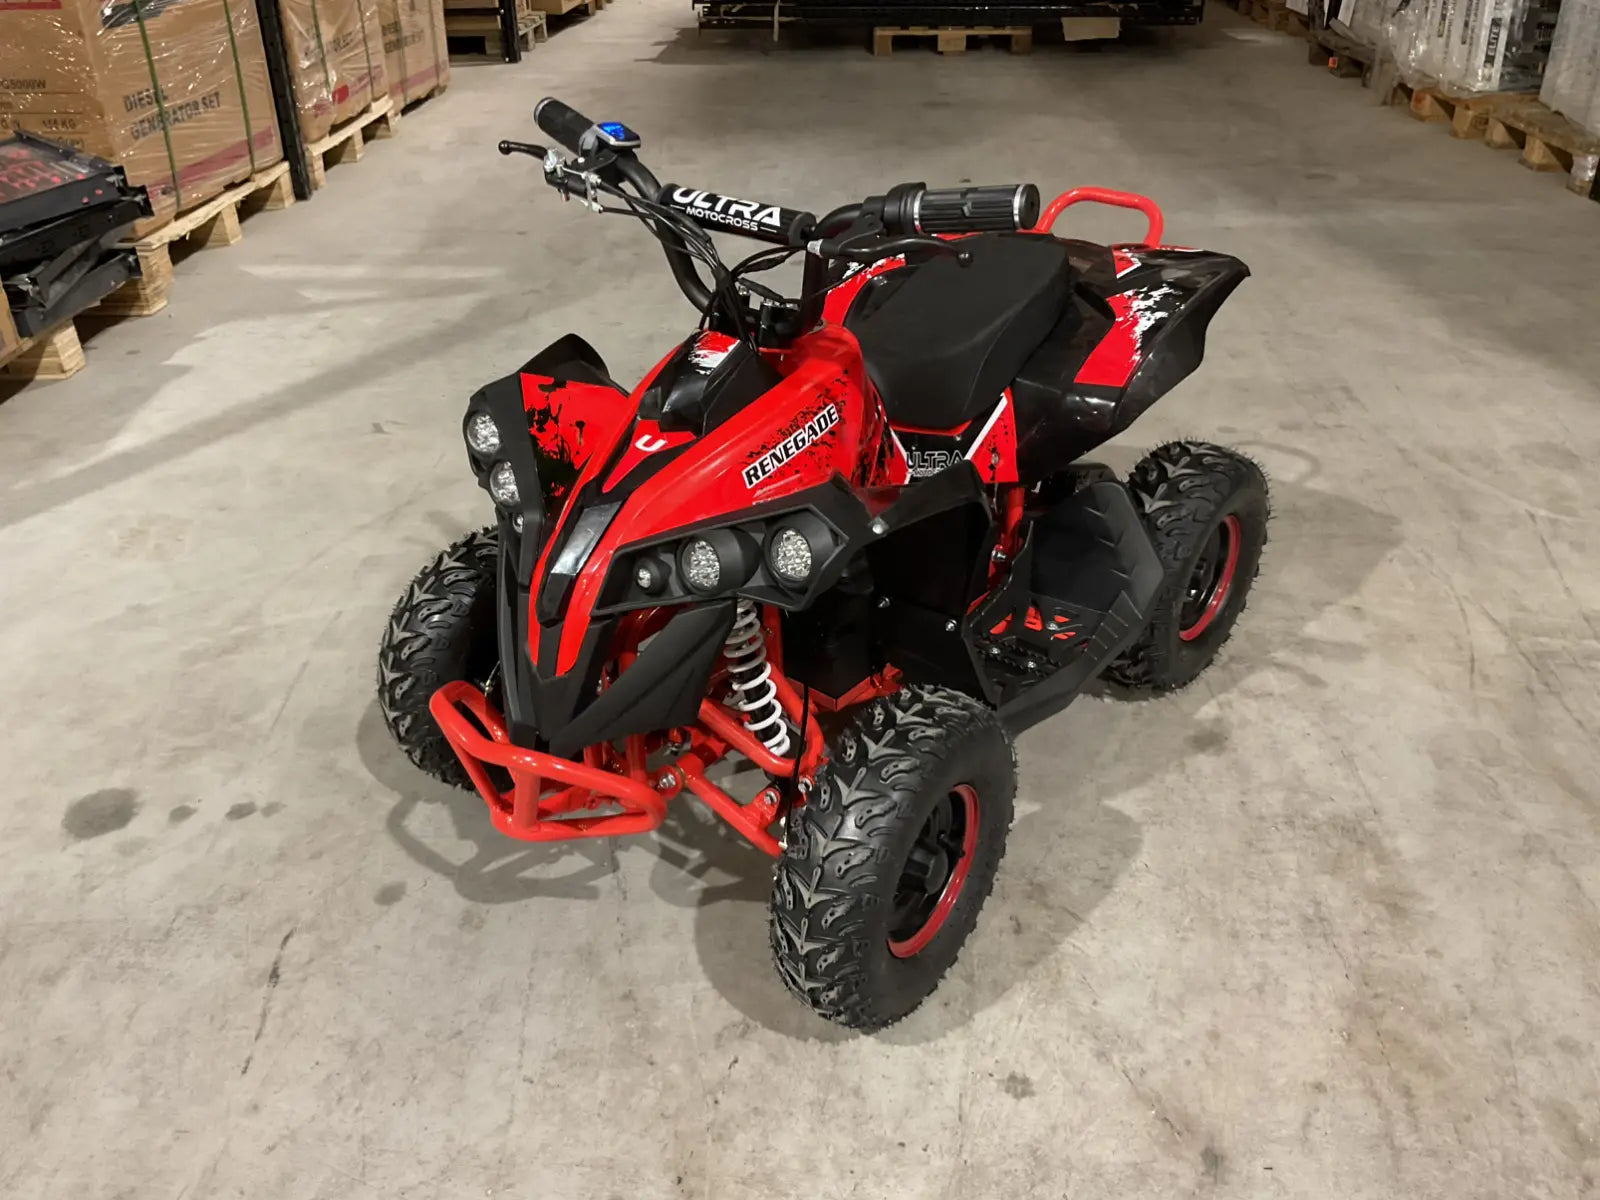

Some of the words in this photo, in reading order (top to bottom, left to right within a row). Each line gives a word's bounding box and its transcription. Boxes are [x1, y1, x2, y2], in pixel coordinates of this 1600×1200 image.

[1487, 25, 1500, 56] ELITE
[202, 91, 220, 109] SET
[673, 187, 781, 227] ULTRA
[686, 206, 758, 231] MOTOCROSS
[743, 404, 838, 487] RENEGADE
[907, 450, 963, 470] ULTRA
